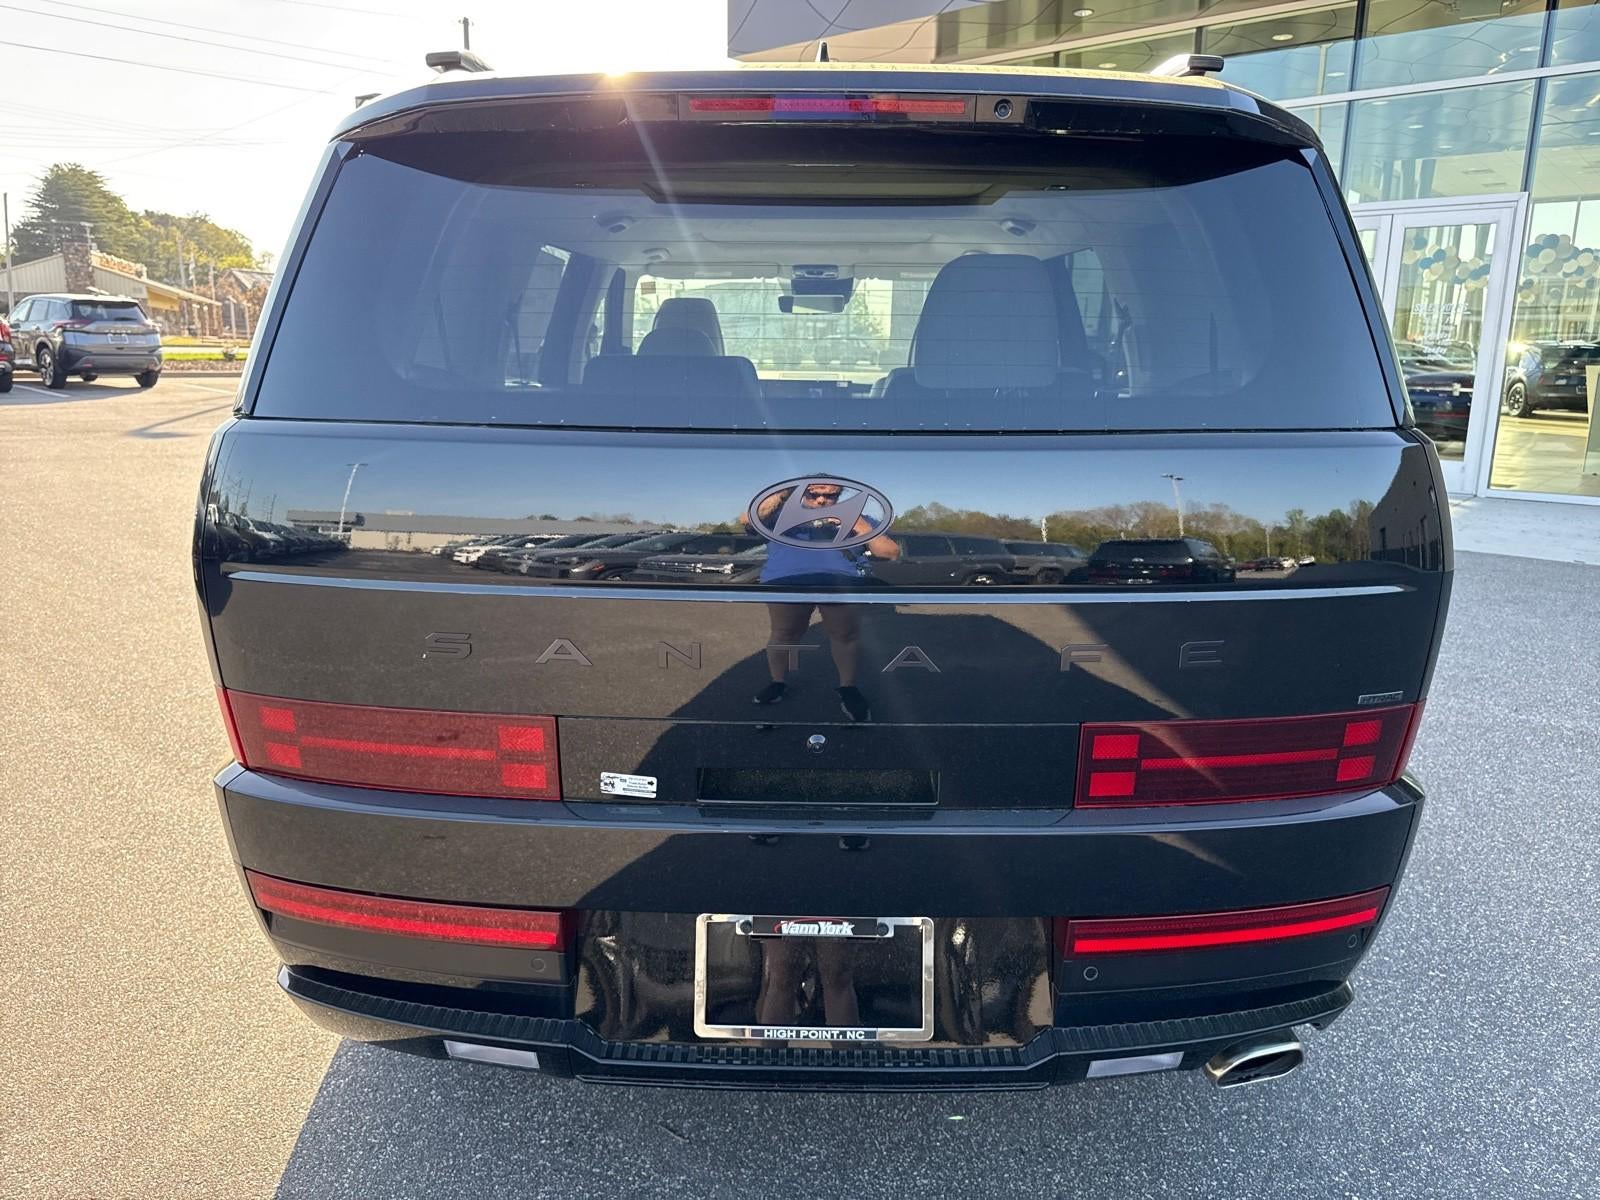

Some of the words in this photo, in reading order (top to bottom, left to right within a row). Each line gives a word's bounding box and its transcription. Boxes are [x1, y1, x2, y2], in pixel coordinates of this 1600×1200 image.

[424, 632, 942, 672] SANTA
[1060, 640, 1226, 672] FE
[764, 1029, 796, 1039] HIGH
[846, 1030, 865, 1040] NC
